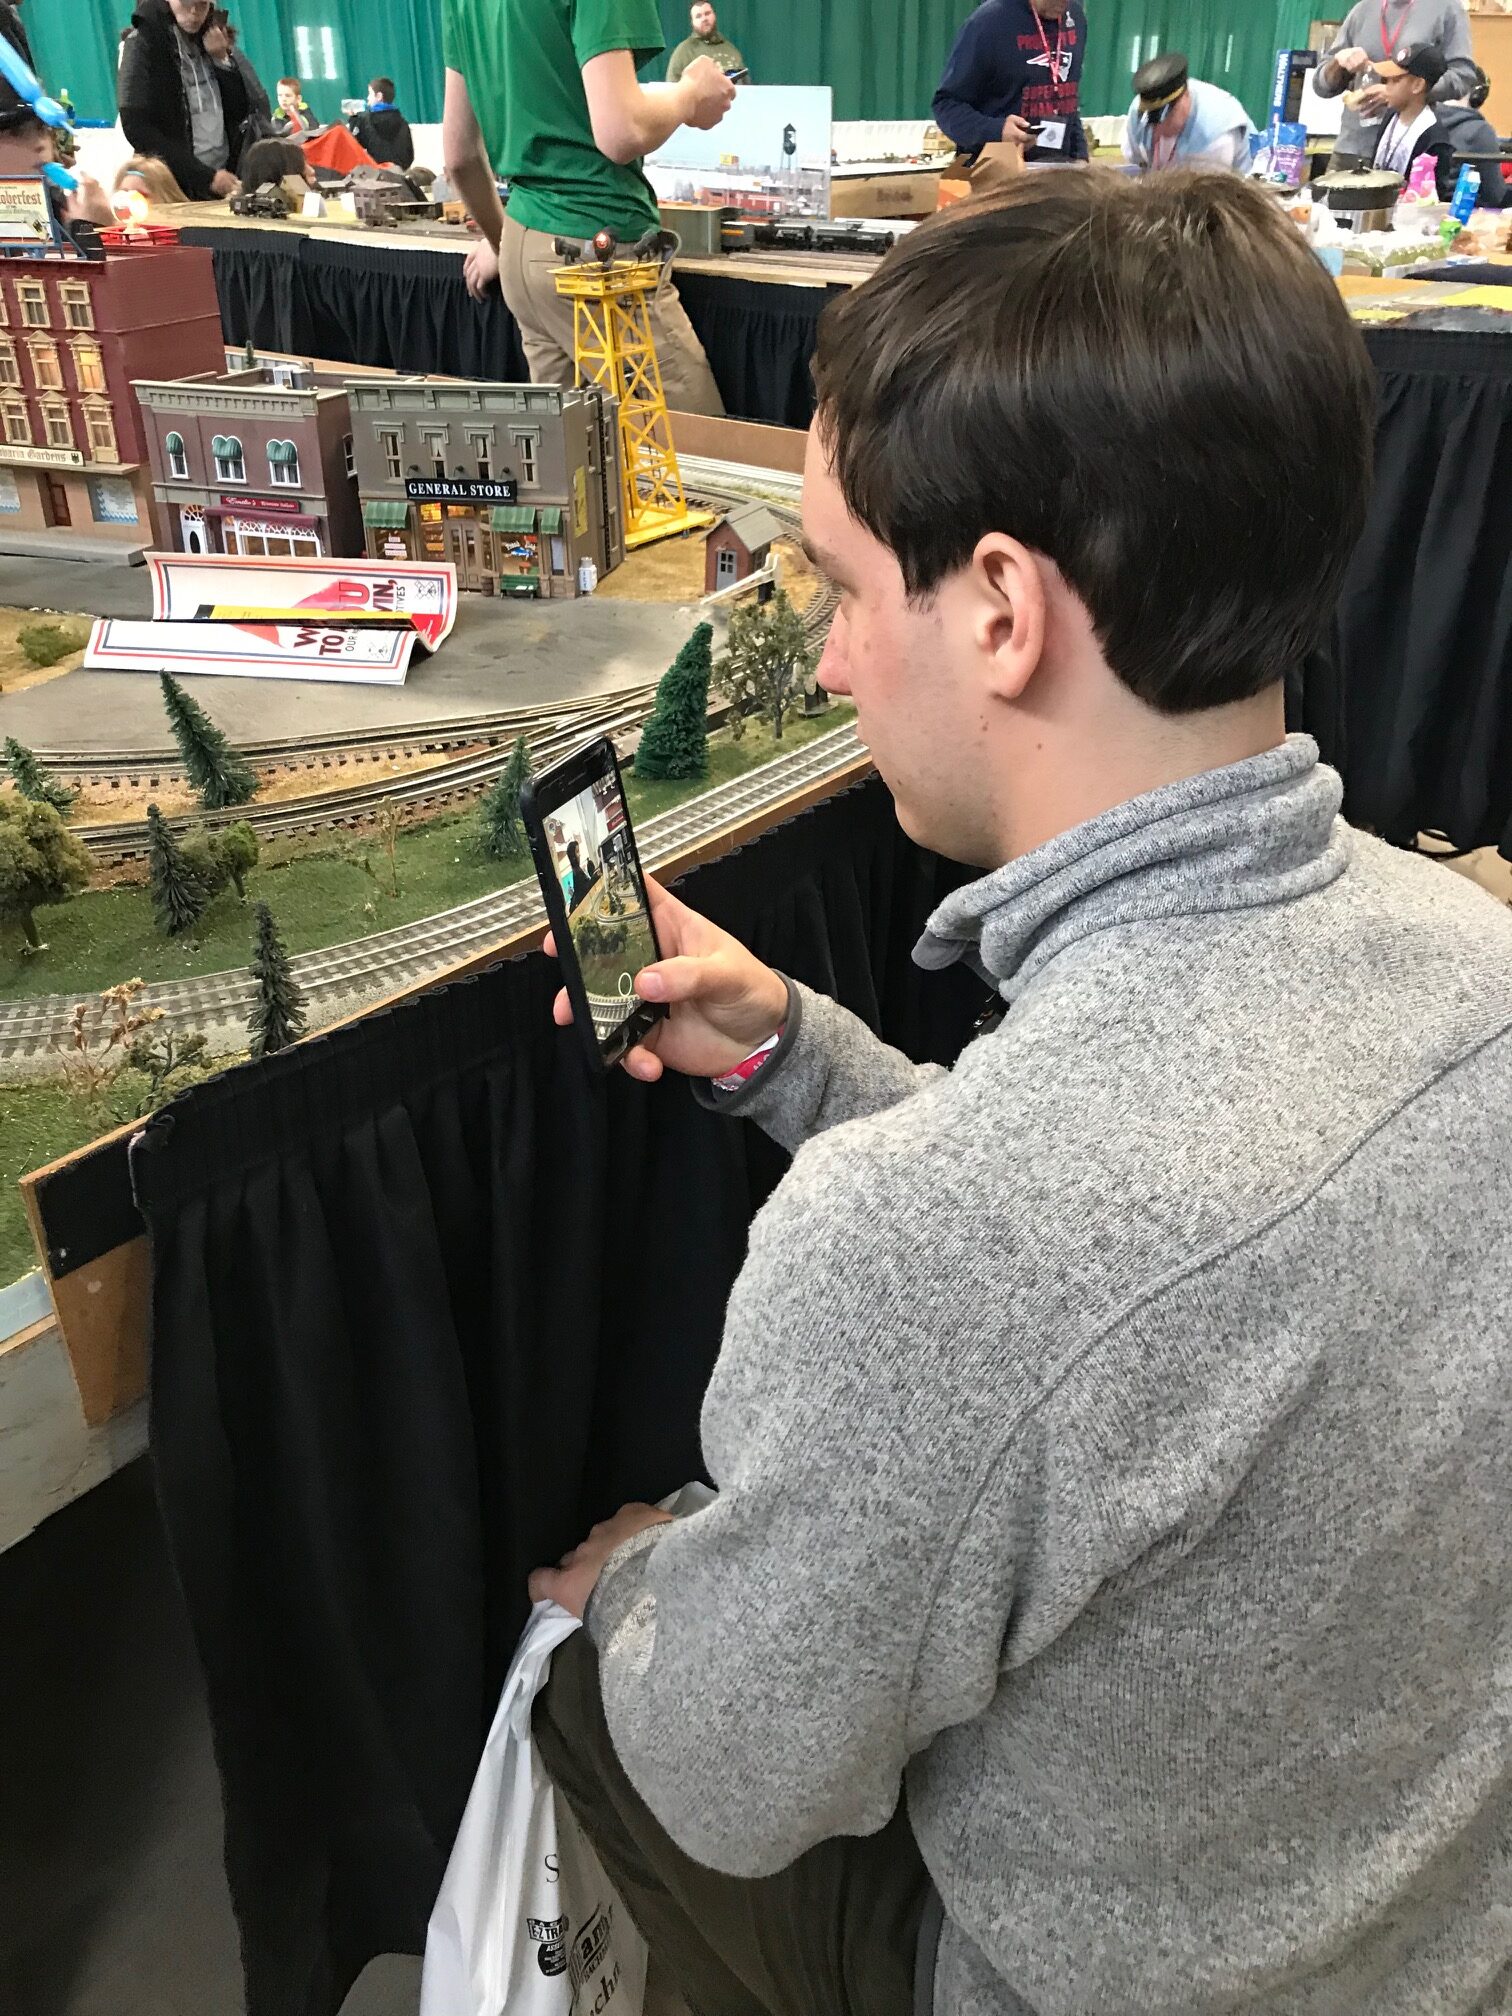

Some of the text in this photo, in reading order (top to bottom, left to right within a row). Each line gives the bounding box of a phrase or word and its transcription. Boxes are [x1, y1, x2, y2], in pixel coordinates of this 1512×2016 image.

[27, 448, 67, 463] Gardens
[408, 482, 511, 498] GENERAL STORE
[318, 634, 345, 656] TO
